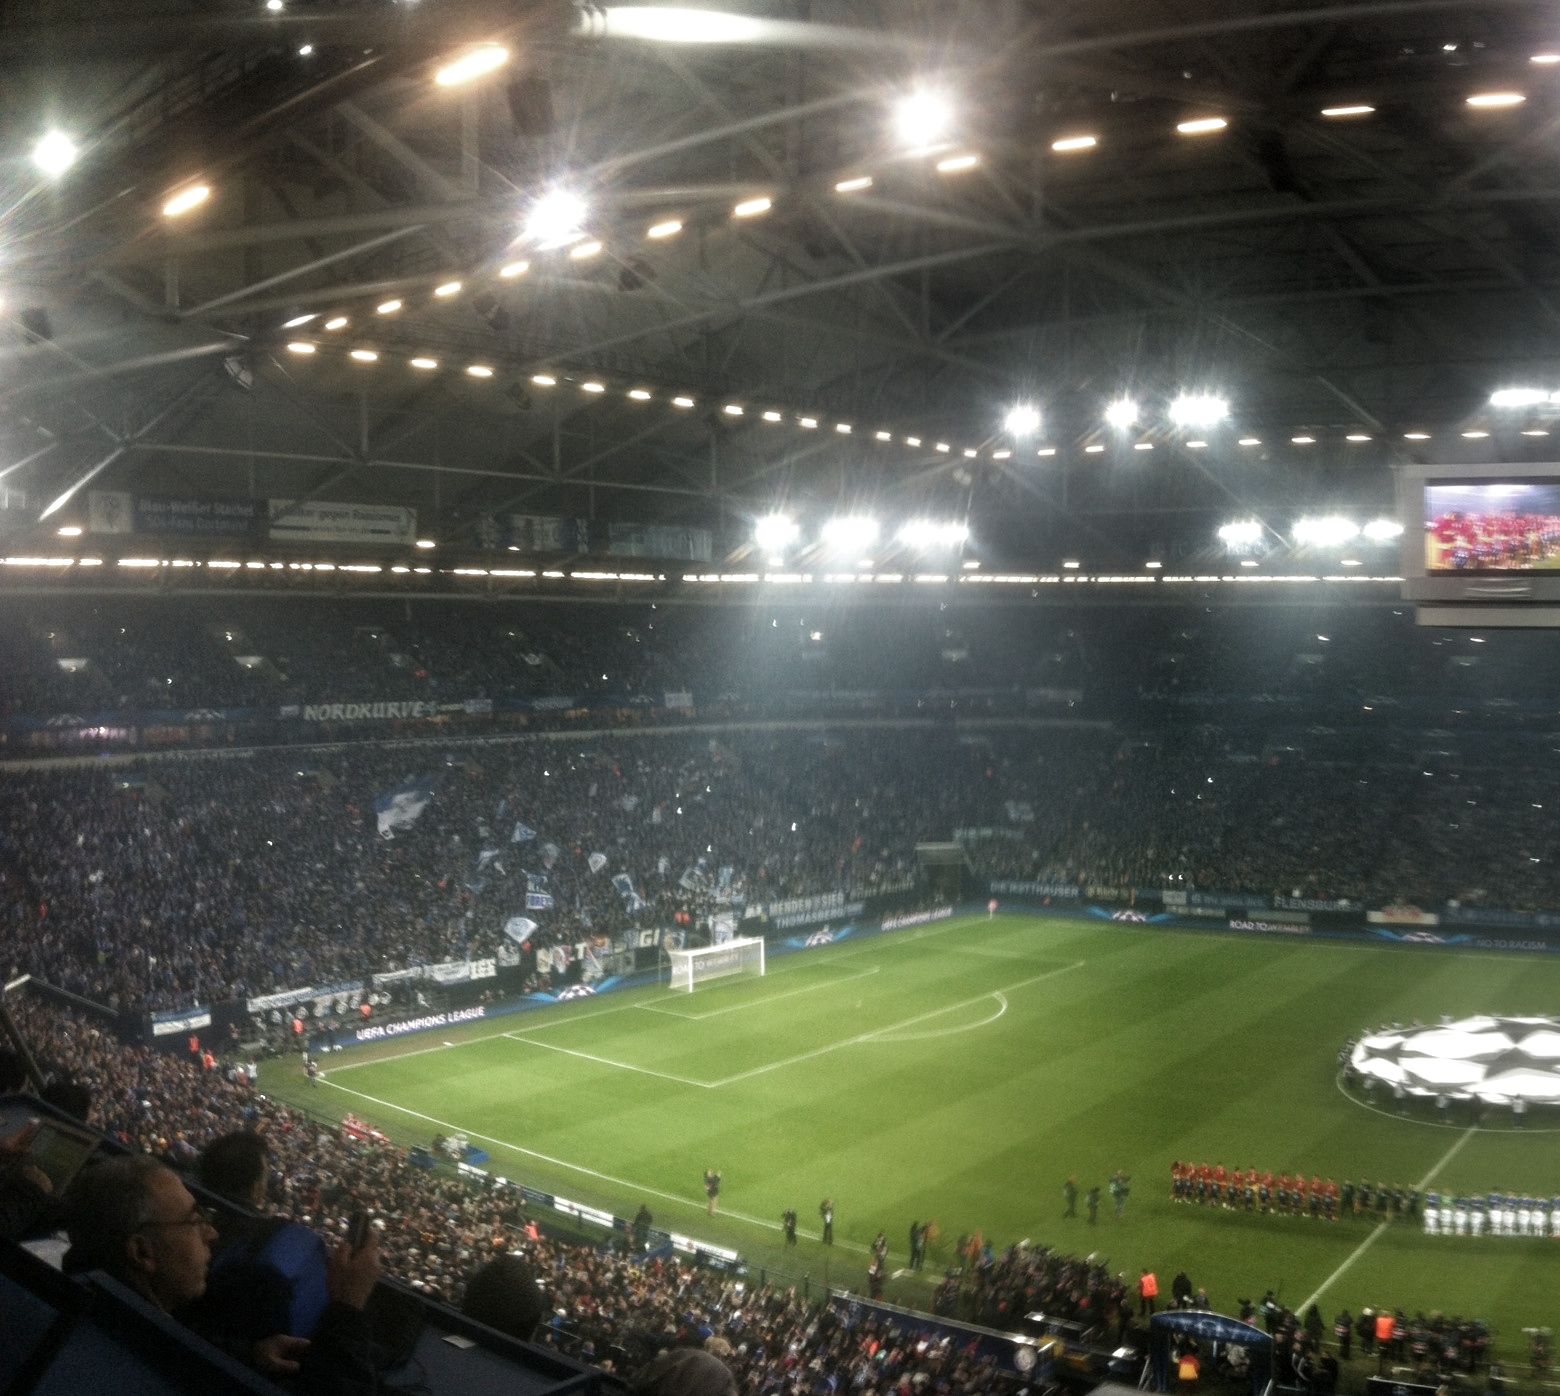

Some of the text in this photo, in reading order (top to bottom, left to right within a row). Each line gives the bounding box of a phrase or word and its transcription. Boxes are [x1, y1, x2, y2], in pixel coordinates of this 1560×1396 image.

[303, 701, 425, 720] NORDKURVE
[1229, 919, 1255, 930] ROAD
[1508, 940, 1546, 950] RACISM
[356, 1006, 486, 1042] UEFA CHAMPIONS LEAGUE
